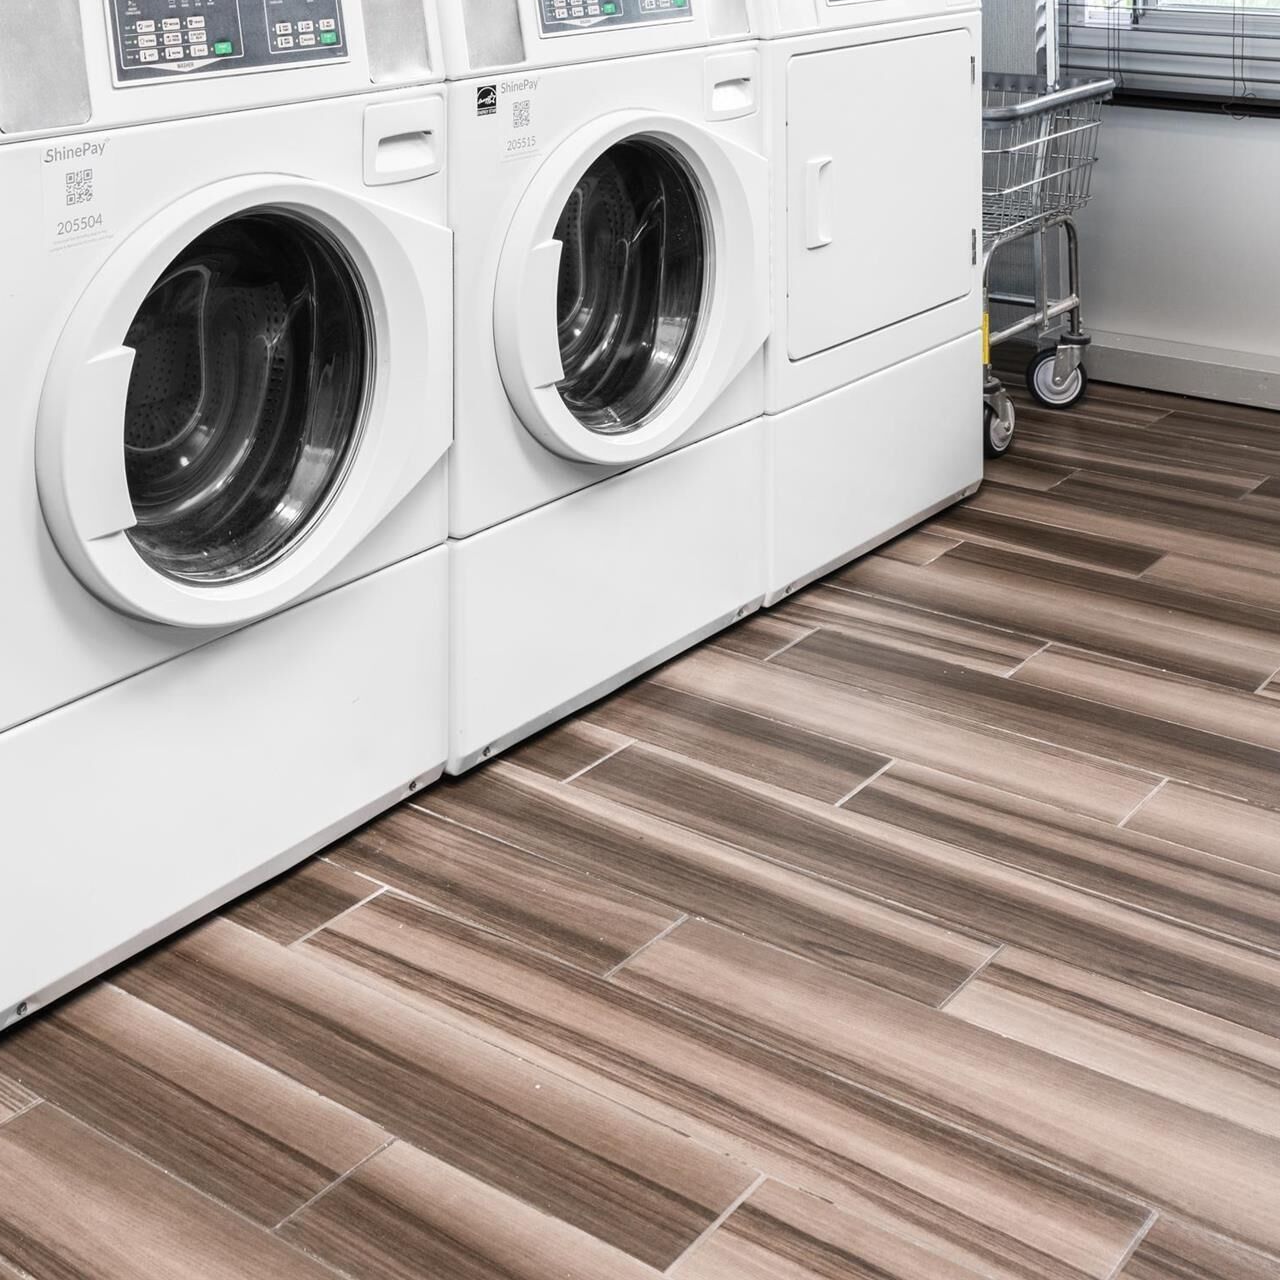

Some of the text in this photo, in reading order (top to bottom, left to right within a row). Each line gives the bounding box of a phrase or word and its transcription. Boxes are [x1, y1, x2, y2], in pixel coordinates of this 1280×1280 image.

[501, 80, 538, 94] ShinePay
[43, 140, 106, 163] ShinePay
[507, 136, 536, 151] 205515
[57, 213, 103, 236] 205504
